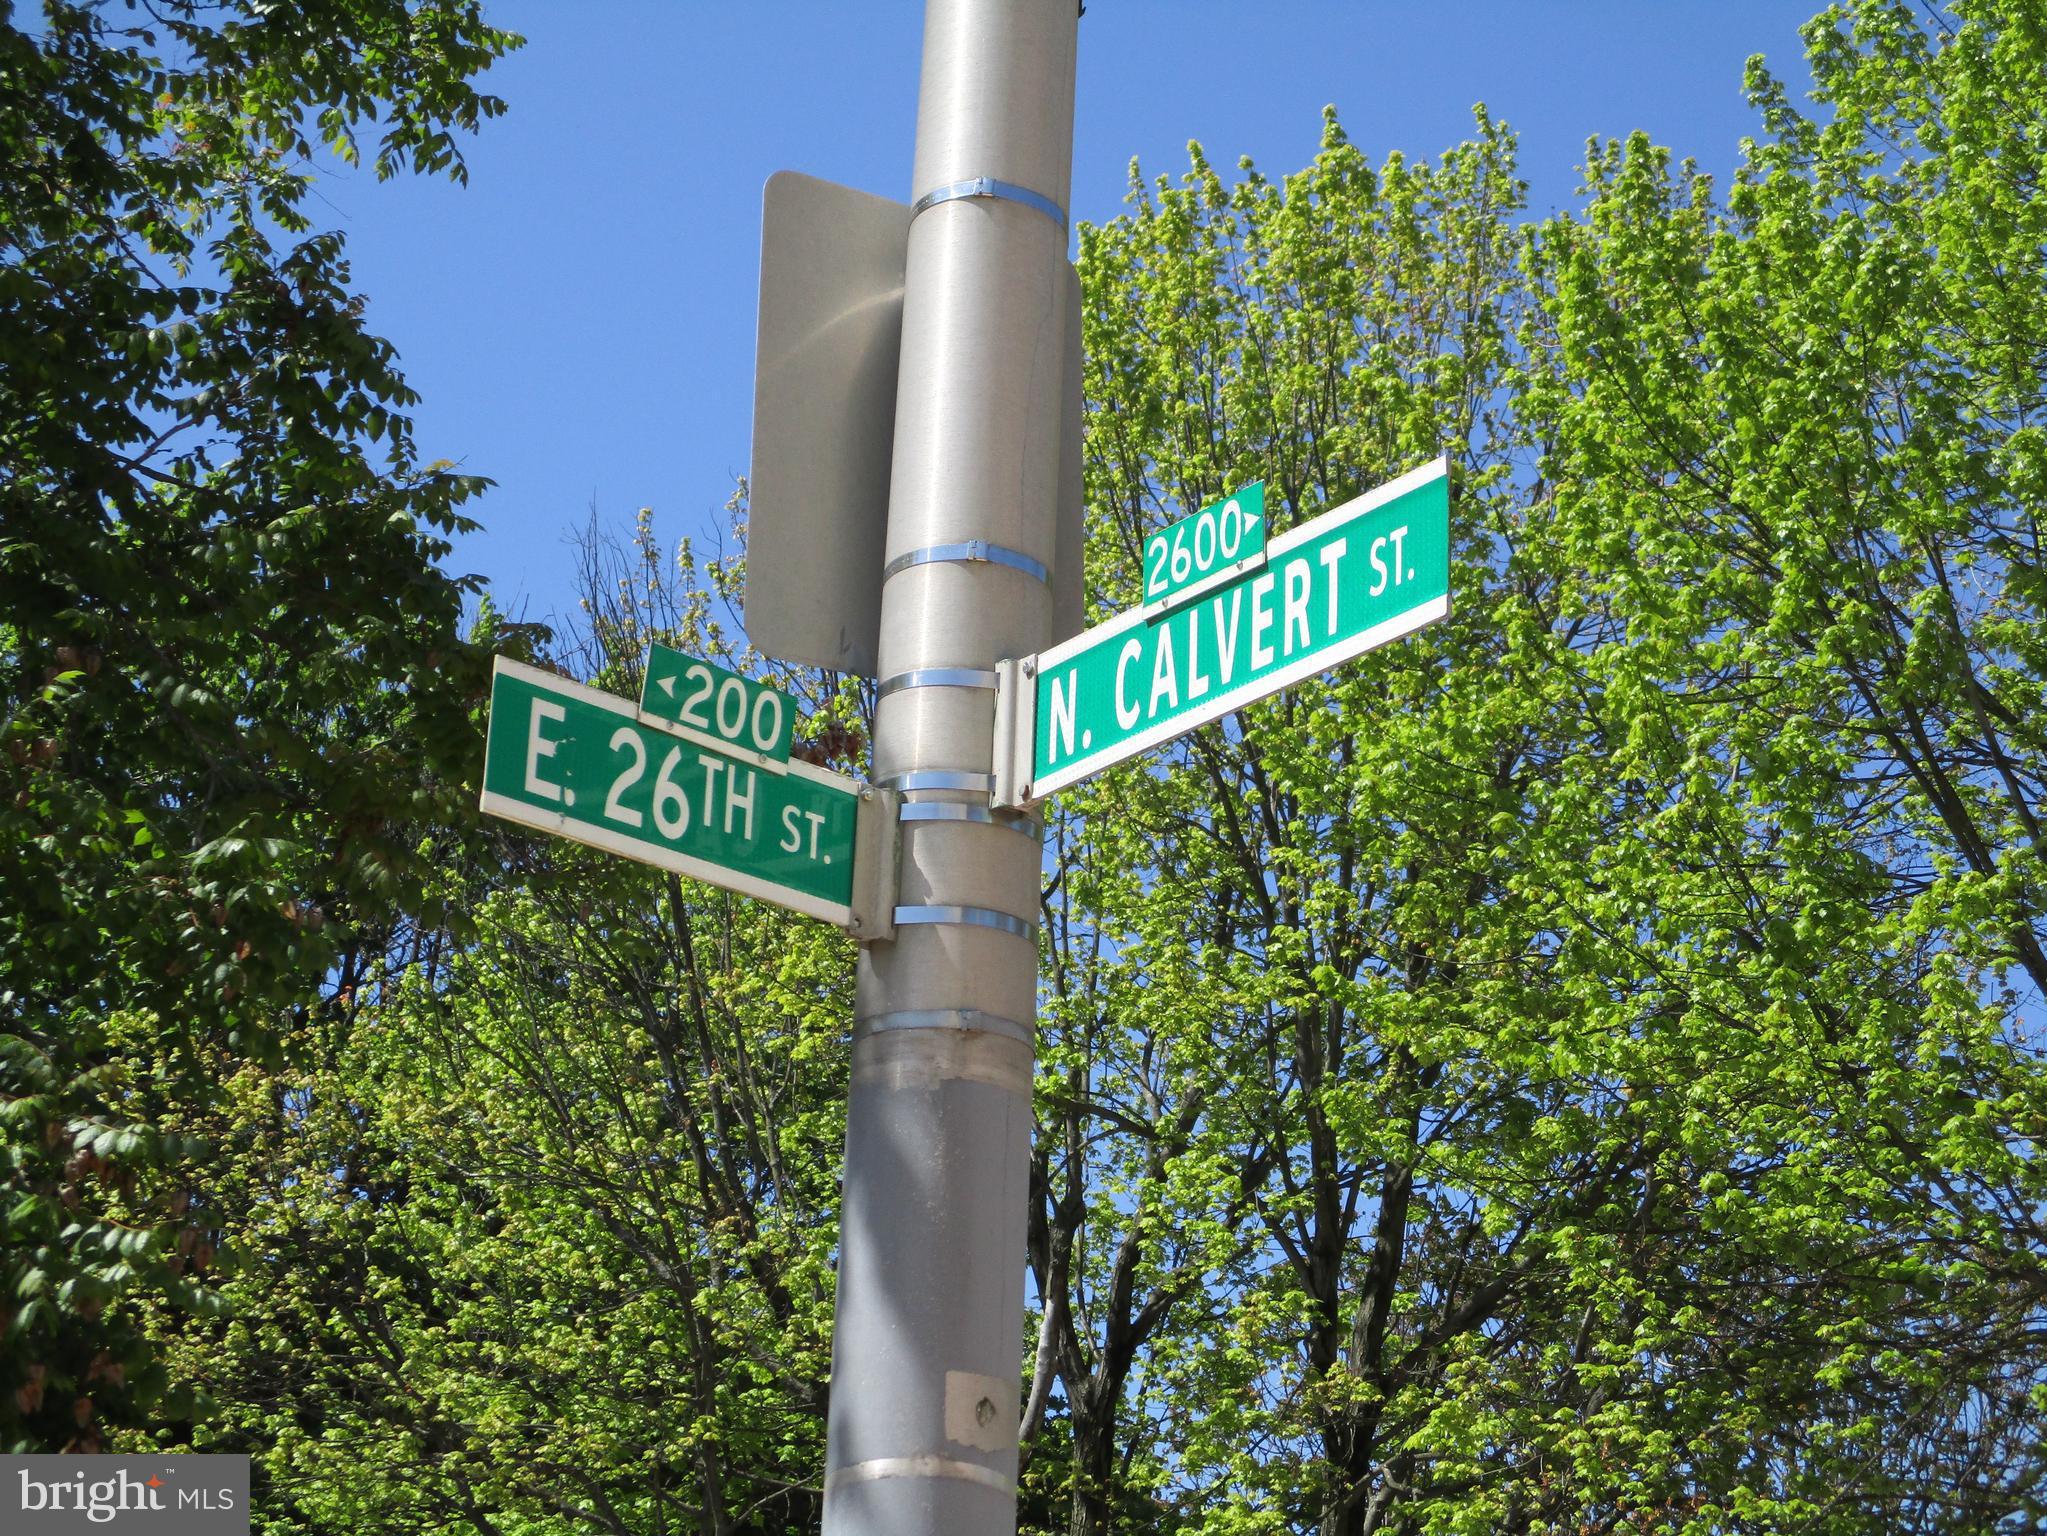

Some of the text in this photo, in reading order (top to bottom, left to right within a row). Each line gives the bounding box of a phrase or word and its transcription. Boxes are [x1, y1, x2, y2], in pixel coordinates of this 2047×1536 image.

[1148, 499, 1242, 597] 2600
[679, 664, 783, 752] 200
[1048, 525, 1415, 765] N. CALVERT ST.
[524, 696, 832, 865] E. 26TH ST.
